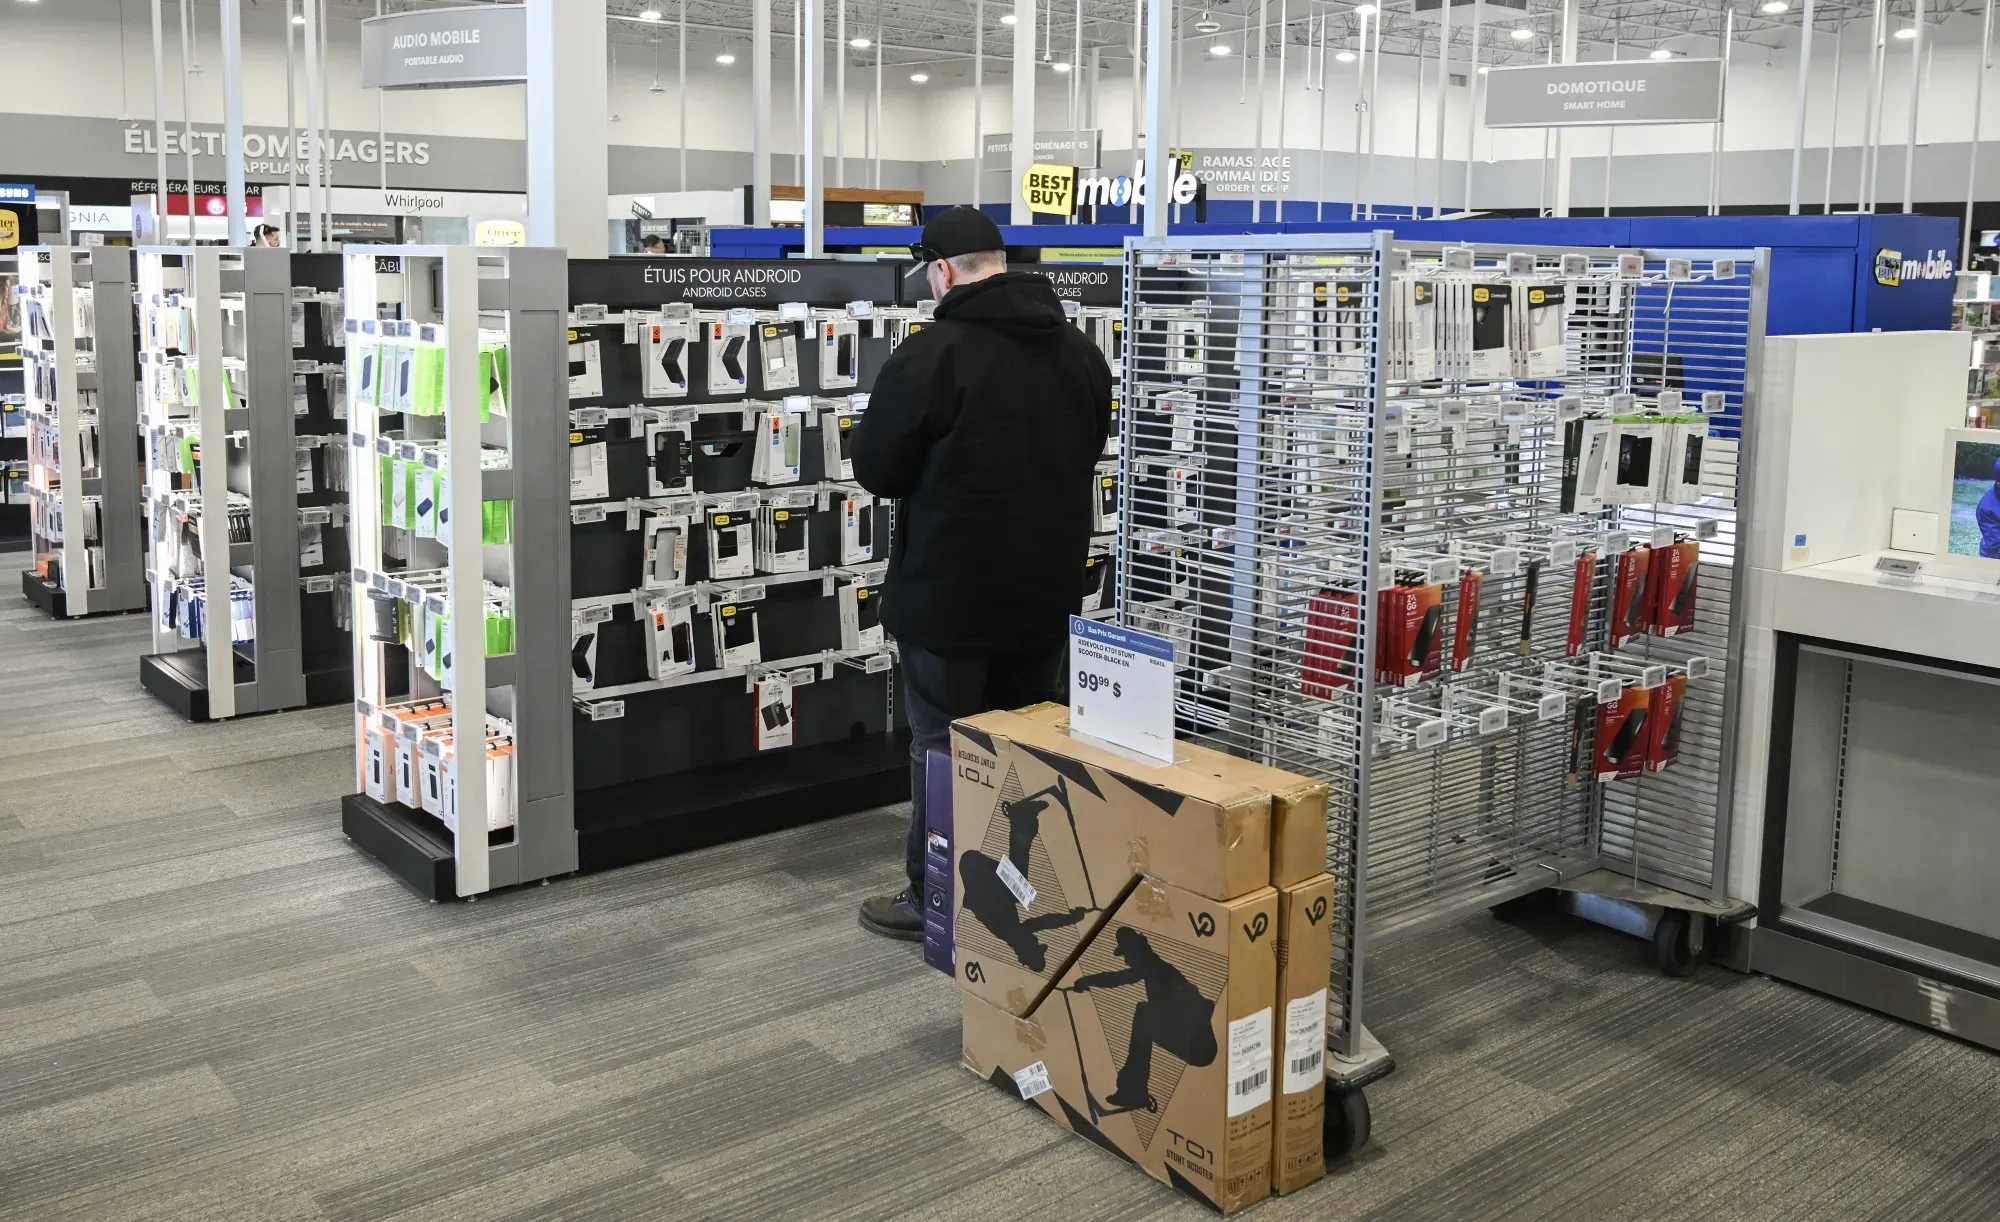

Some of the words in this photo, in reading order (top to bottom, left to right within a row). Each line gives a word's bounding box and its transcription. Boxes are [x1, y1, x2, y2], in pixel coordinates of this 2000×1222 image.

[392, 32, 428, 49] AUDIO
[430, 29, 481, 46] MOBILE
[404, 56, 438, 66] PORTABLE
[439, 54, 464, 64] AUDIO
[1546, 79, 1647, 95] DOMOTIQUE
[1563, 101, 1595, 110] SMART
[1596, 100, 1627, 109] HOME
[124, 123, 430, 166] ÉLECTOMÉNAGERS
[987, 144, 1007, 153] PETITS
[1029, 173, 1071, 191] BEST
[1077, 158, 1197, 208] moble
[1216, 184, 1250, 193] ORDER
[385, 194, 444, 211] Whirlpool
[1030, 189, 1067, 207] BUY
[1901, 249, 1953, 280] mobile
[644, 265, 686, 283] ÉTUIS
[690, 268, 731, 283] POUR
[733, 268, 802, 283] ANDROID
[1057, 272, 1108, 285] ANDROID
[682, 286, 733, 298] ANDROID
[734, 286, 767, 298] CASES
[1057, 287, 1082, 297] CASES
[1087, 626, 1098, 634] Bas
[1097, 628, 1107, 637] Prix
[1107, 631, 1127, 642] Garanti
[1078, 647, 1122, 666] SCOOTER-BLACK
[1122, 660, 1130, 668] EN
[1117, 650, 1135, 660] STUNT
[1112, 681, 1122, 698] $
[958, 749, 980, 765] SCOOTER
[980, 757, 996, 770] STUNT
[1166, 1149, 1186, 1166] STUNT
[1186, 1158, 1214, 1180] SCOOTER
